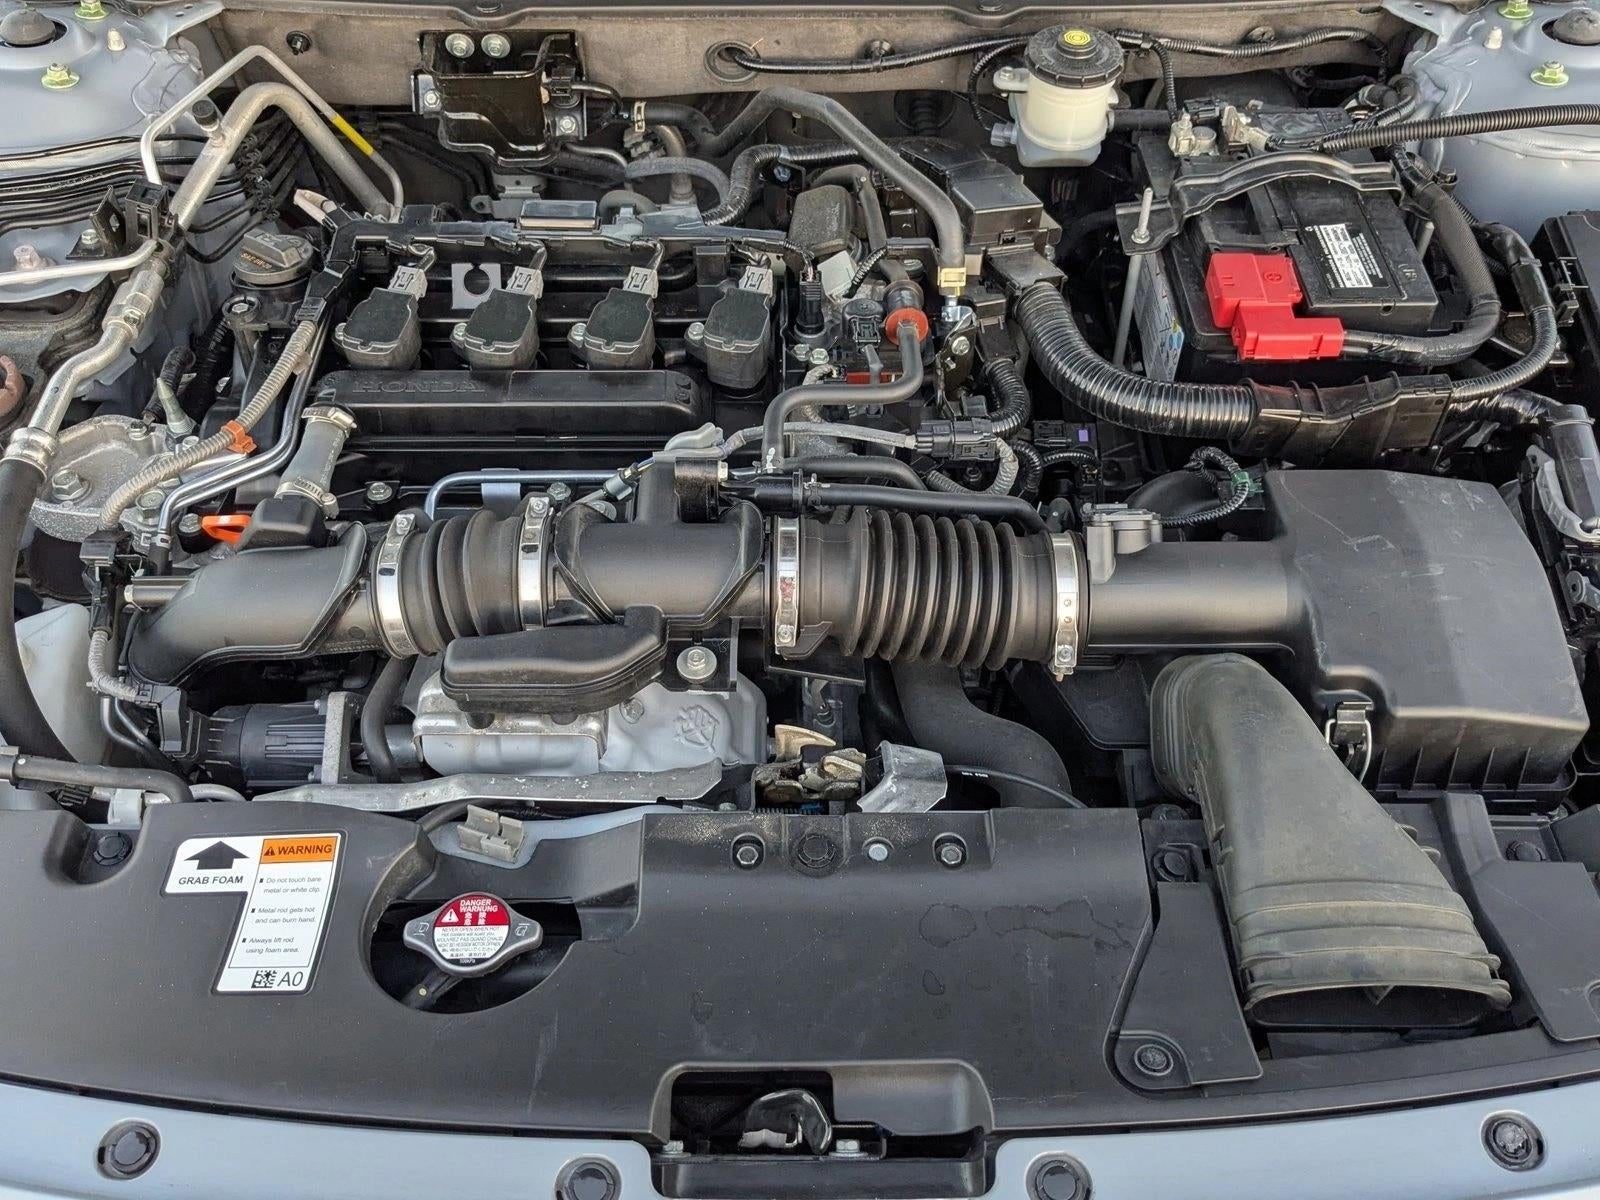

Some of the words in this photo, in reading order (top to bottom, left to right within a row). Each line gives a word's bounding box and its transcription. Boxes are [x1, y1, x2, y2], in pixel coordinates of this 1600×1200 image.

[352, 381, 485, 393] HONDA
[277, 844, 333, 855] WARNING
[178, 876, 209, 885] GRAB
[212, 875, 244, 884] FOAM
[460, 899, 492, 907] DANGER
[277, 971, 304, 987] A0
